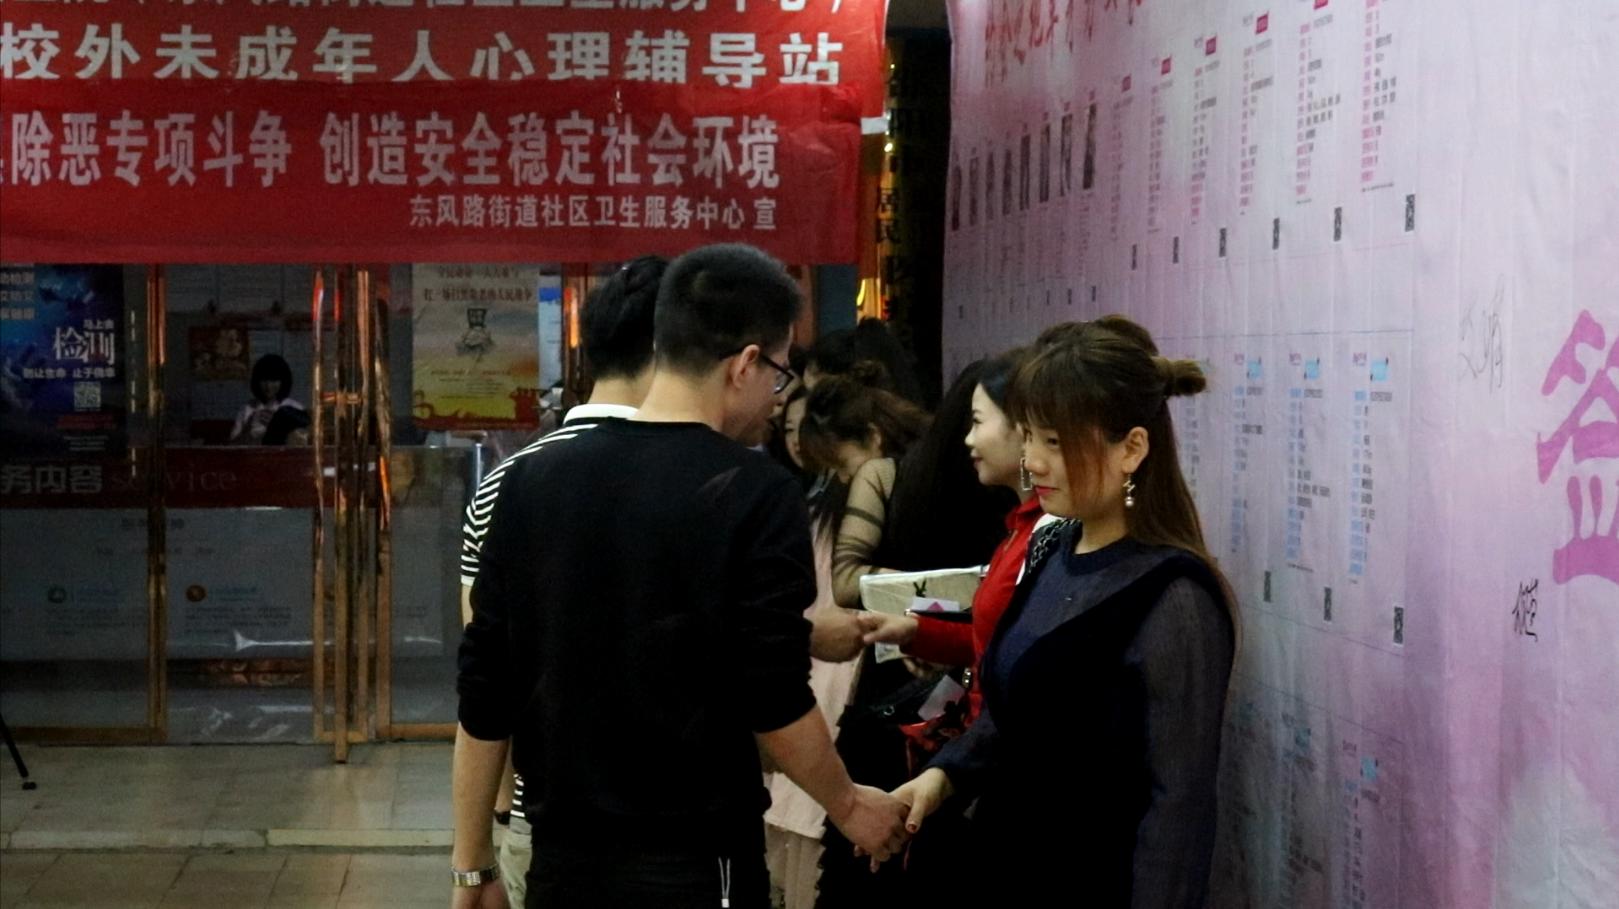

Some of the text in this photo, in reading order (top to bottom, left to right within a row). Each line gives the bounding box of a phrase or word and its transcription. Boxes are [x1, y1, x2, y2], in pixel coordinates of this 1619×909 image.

[0, 22, 842, 88] 校外未成年人心理辅导站
[0, 110, 780, 189] 除恶专项斗争 创造安全稳定社会环境
[410, 194, 777, 230] 东风路街道社区卫生服务中心 宣
